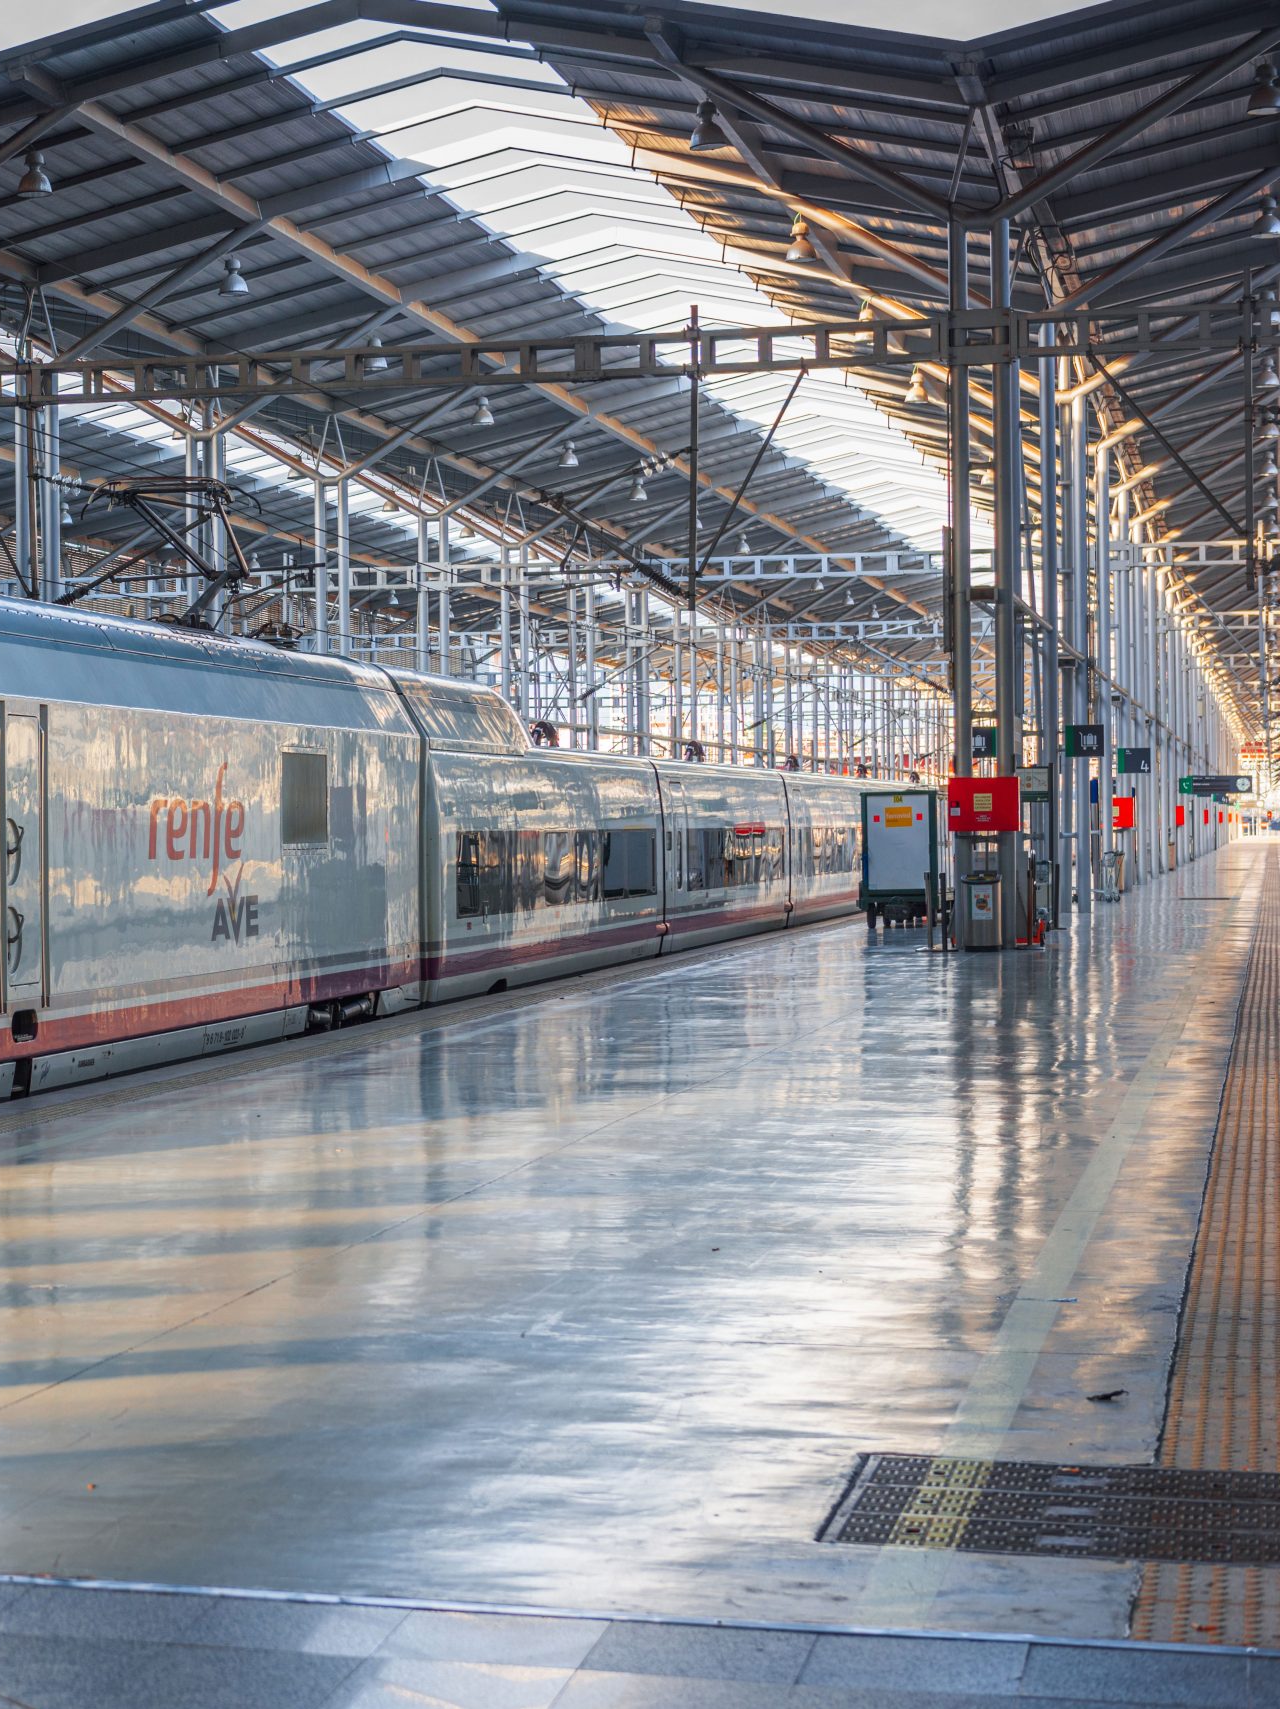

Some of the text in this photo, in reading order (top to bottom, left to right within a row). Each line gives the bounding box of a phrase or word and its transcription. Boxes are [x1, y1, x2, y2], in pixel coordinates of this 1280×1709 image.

[1140, 760, 1150, 773] 4
[148, 762, 245, 897] renfe
[211, 866, 259, 946] AVE
